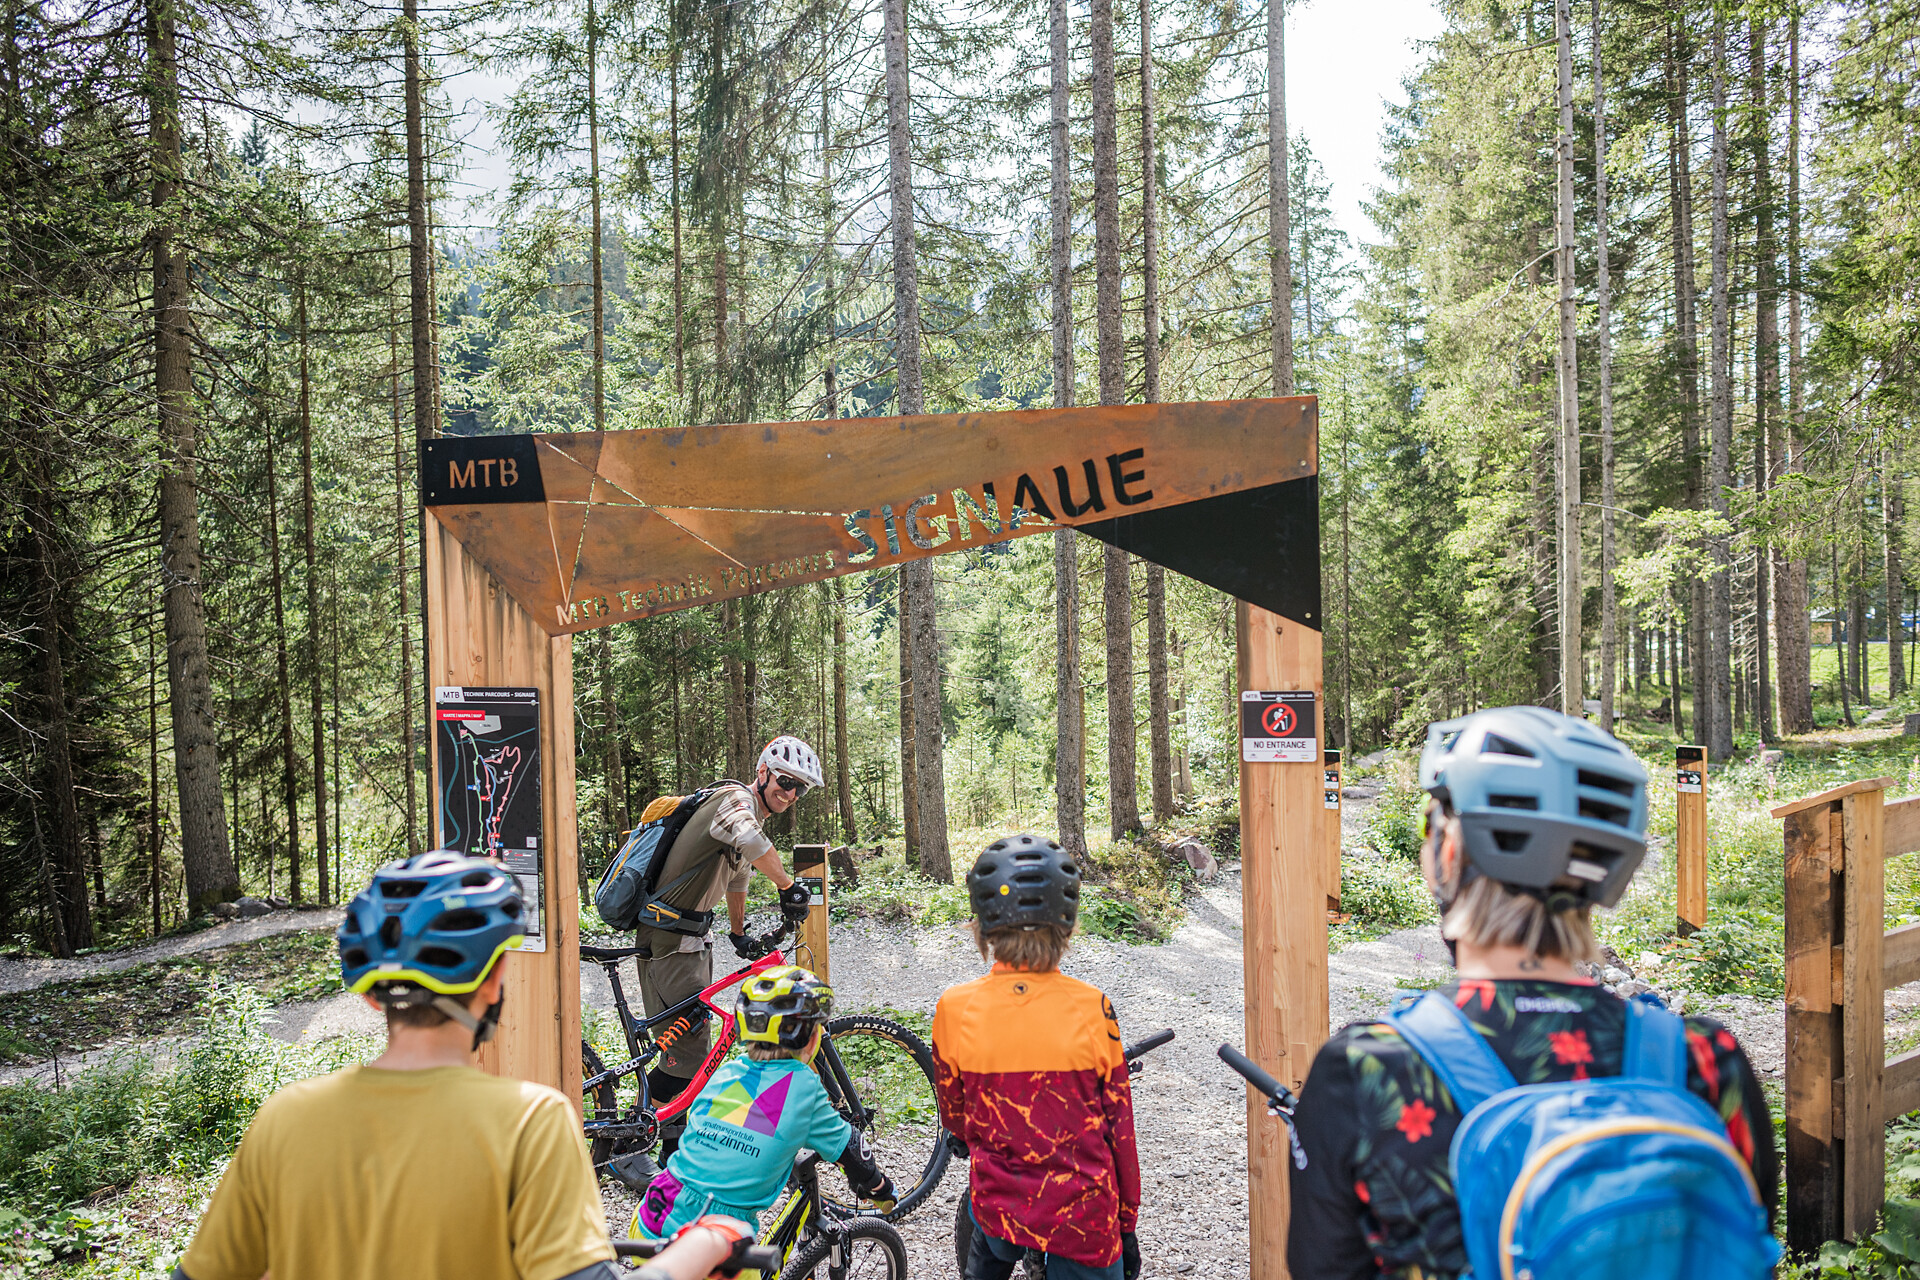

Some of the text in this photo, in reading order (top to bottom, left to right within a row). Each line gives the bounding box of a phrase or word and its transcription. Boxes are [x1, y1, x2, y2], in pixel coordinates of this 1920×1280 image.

[449, 458, 519, 488] MTB
[844, 447, 1153, 564] SIGNAUE
[555, 550, 836, 626] MTB Technik Parcours
[443, 691, 460, 699] MTB
[1253, 741, 1307, 749] NO ENTRANCE
[853, 1022, 899, 1035] MAXXIS
[704, 1039, 729, 1077] ROCKY
[696, 1127, 761, 1158] drei zinnen
[702, 1121, 755, 1142] amateursportclub
